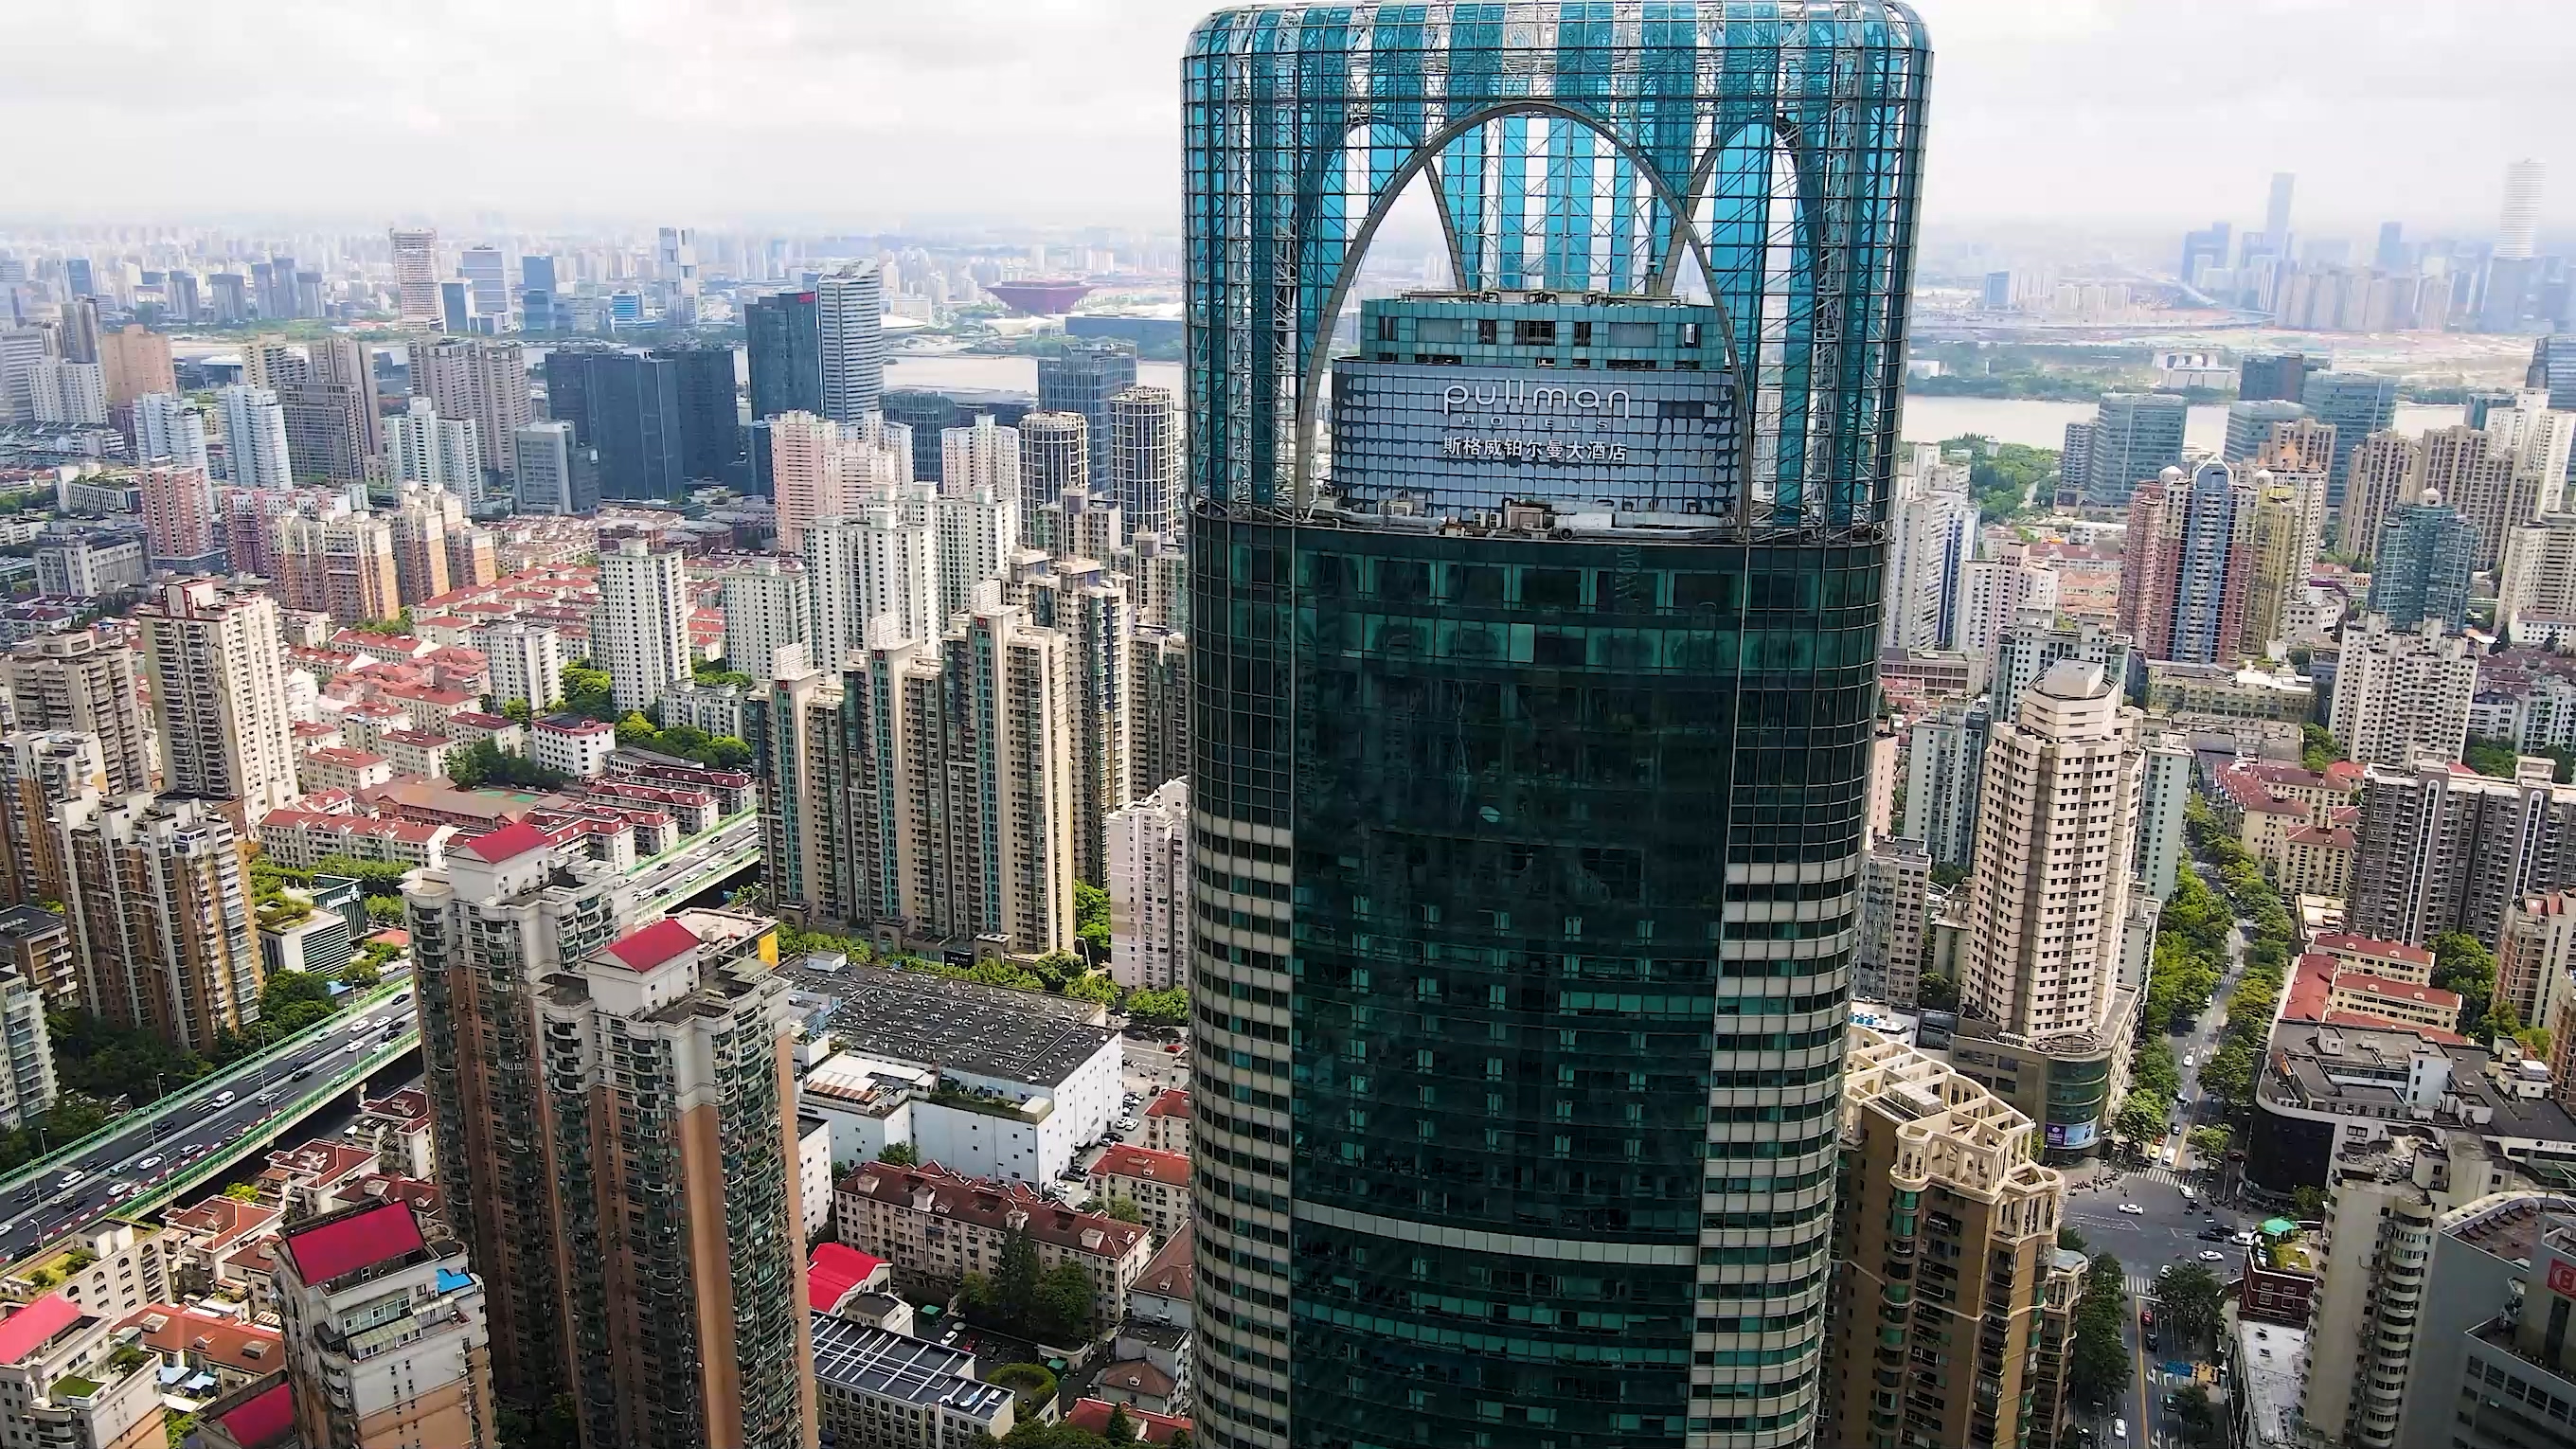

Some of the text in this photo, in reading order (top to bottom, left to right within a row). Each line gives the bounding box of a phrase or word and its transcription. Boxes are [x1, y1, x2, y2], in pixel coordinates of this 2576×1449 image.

[1443, 379, 1630, 420] pullman
[1461, 415, 1609, 429] HOTELS
[1442, 435, 1628, 462] 斯格威铂尔曼大酒店
